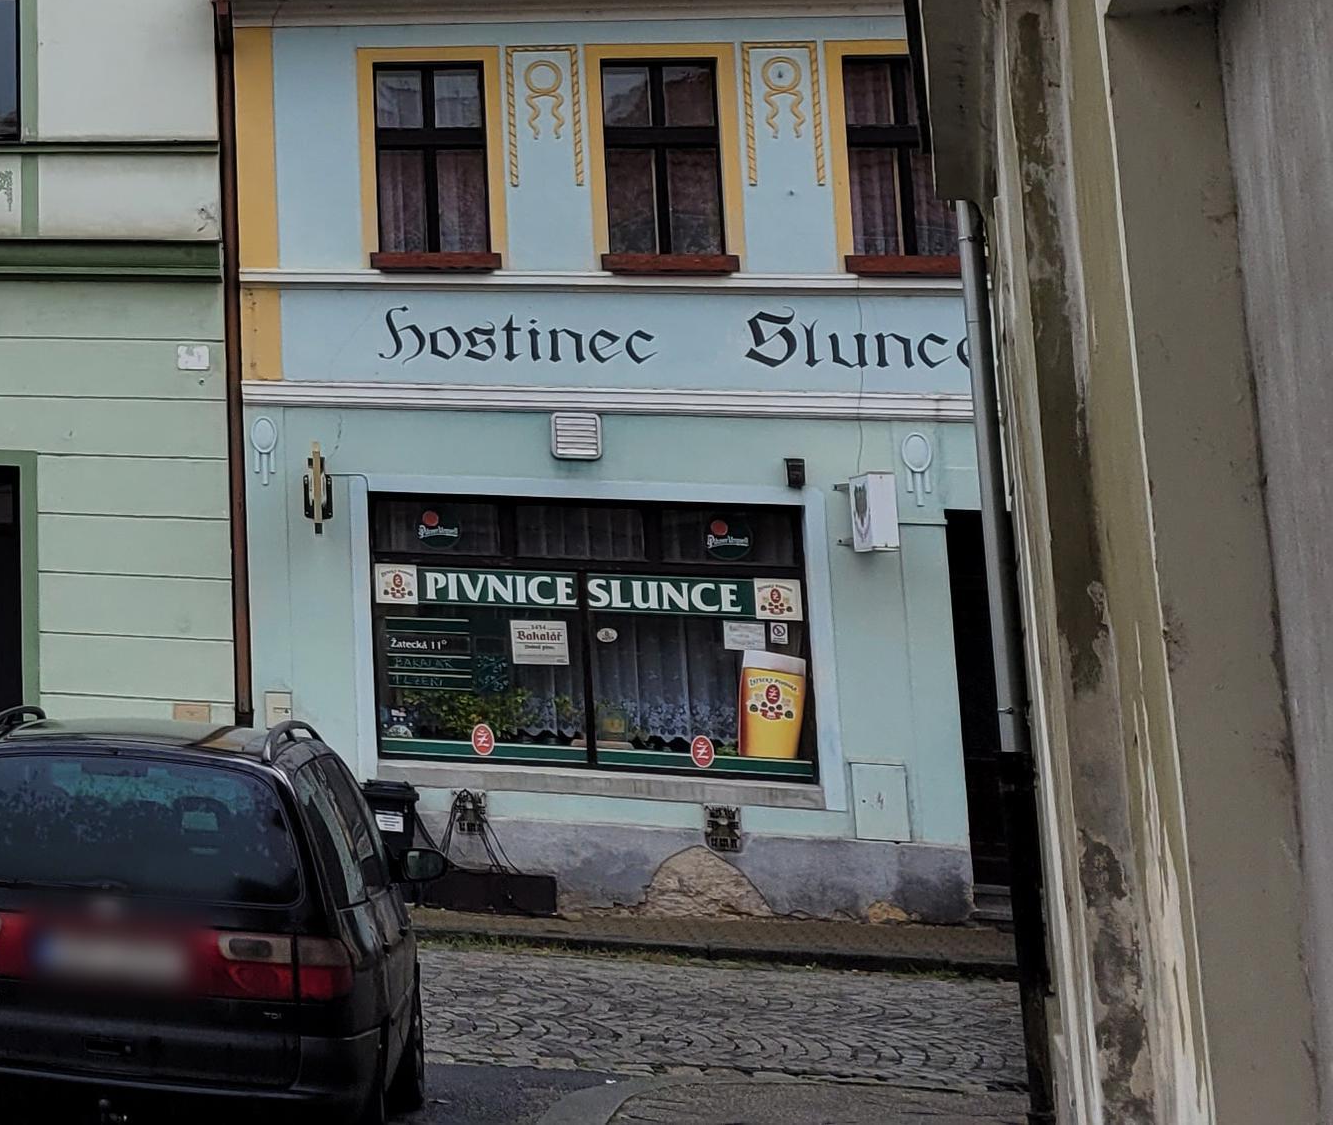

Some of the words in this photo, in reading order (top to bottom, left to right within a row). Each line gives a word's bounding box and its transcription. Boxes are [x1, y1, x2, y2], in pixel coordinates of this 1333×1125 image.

[424, 571, 577, 606] PIVNICE
[587, 578, 742, 613] SLUNCE
[390, 637, 428, 650] Žatecká
[696, 741, 710, 759] Ž
